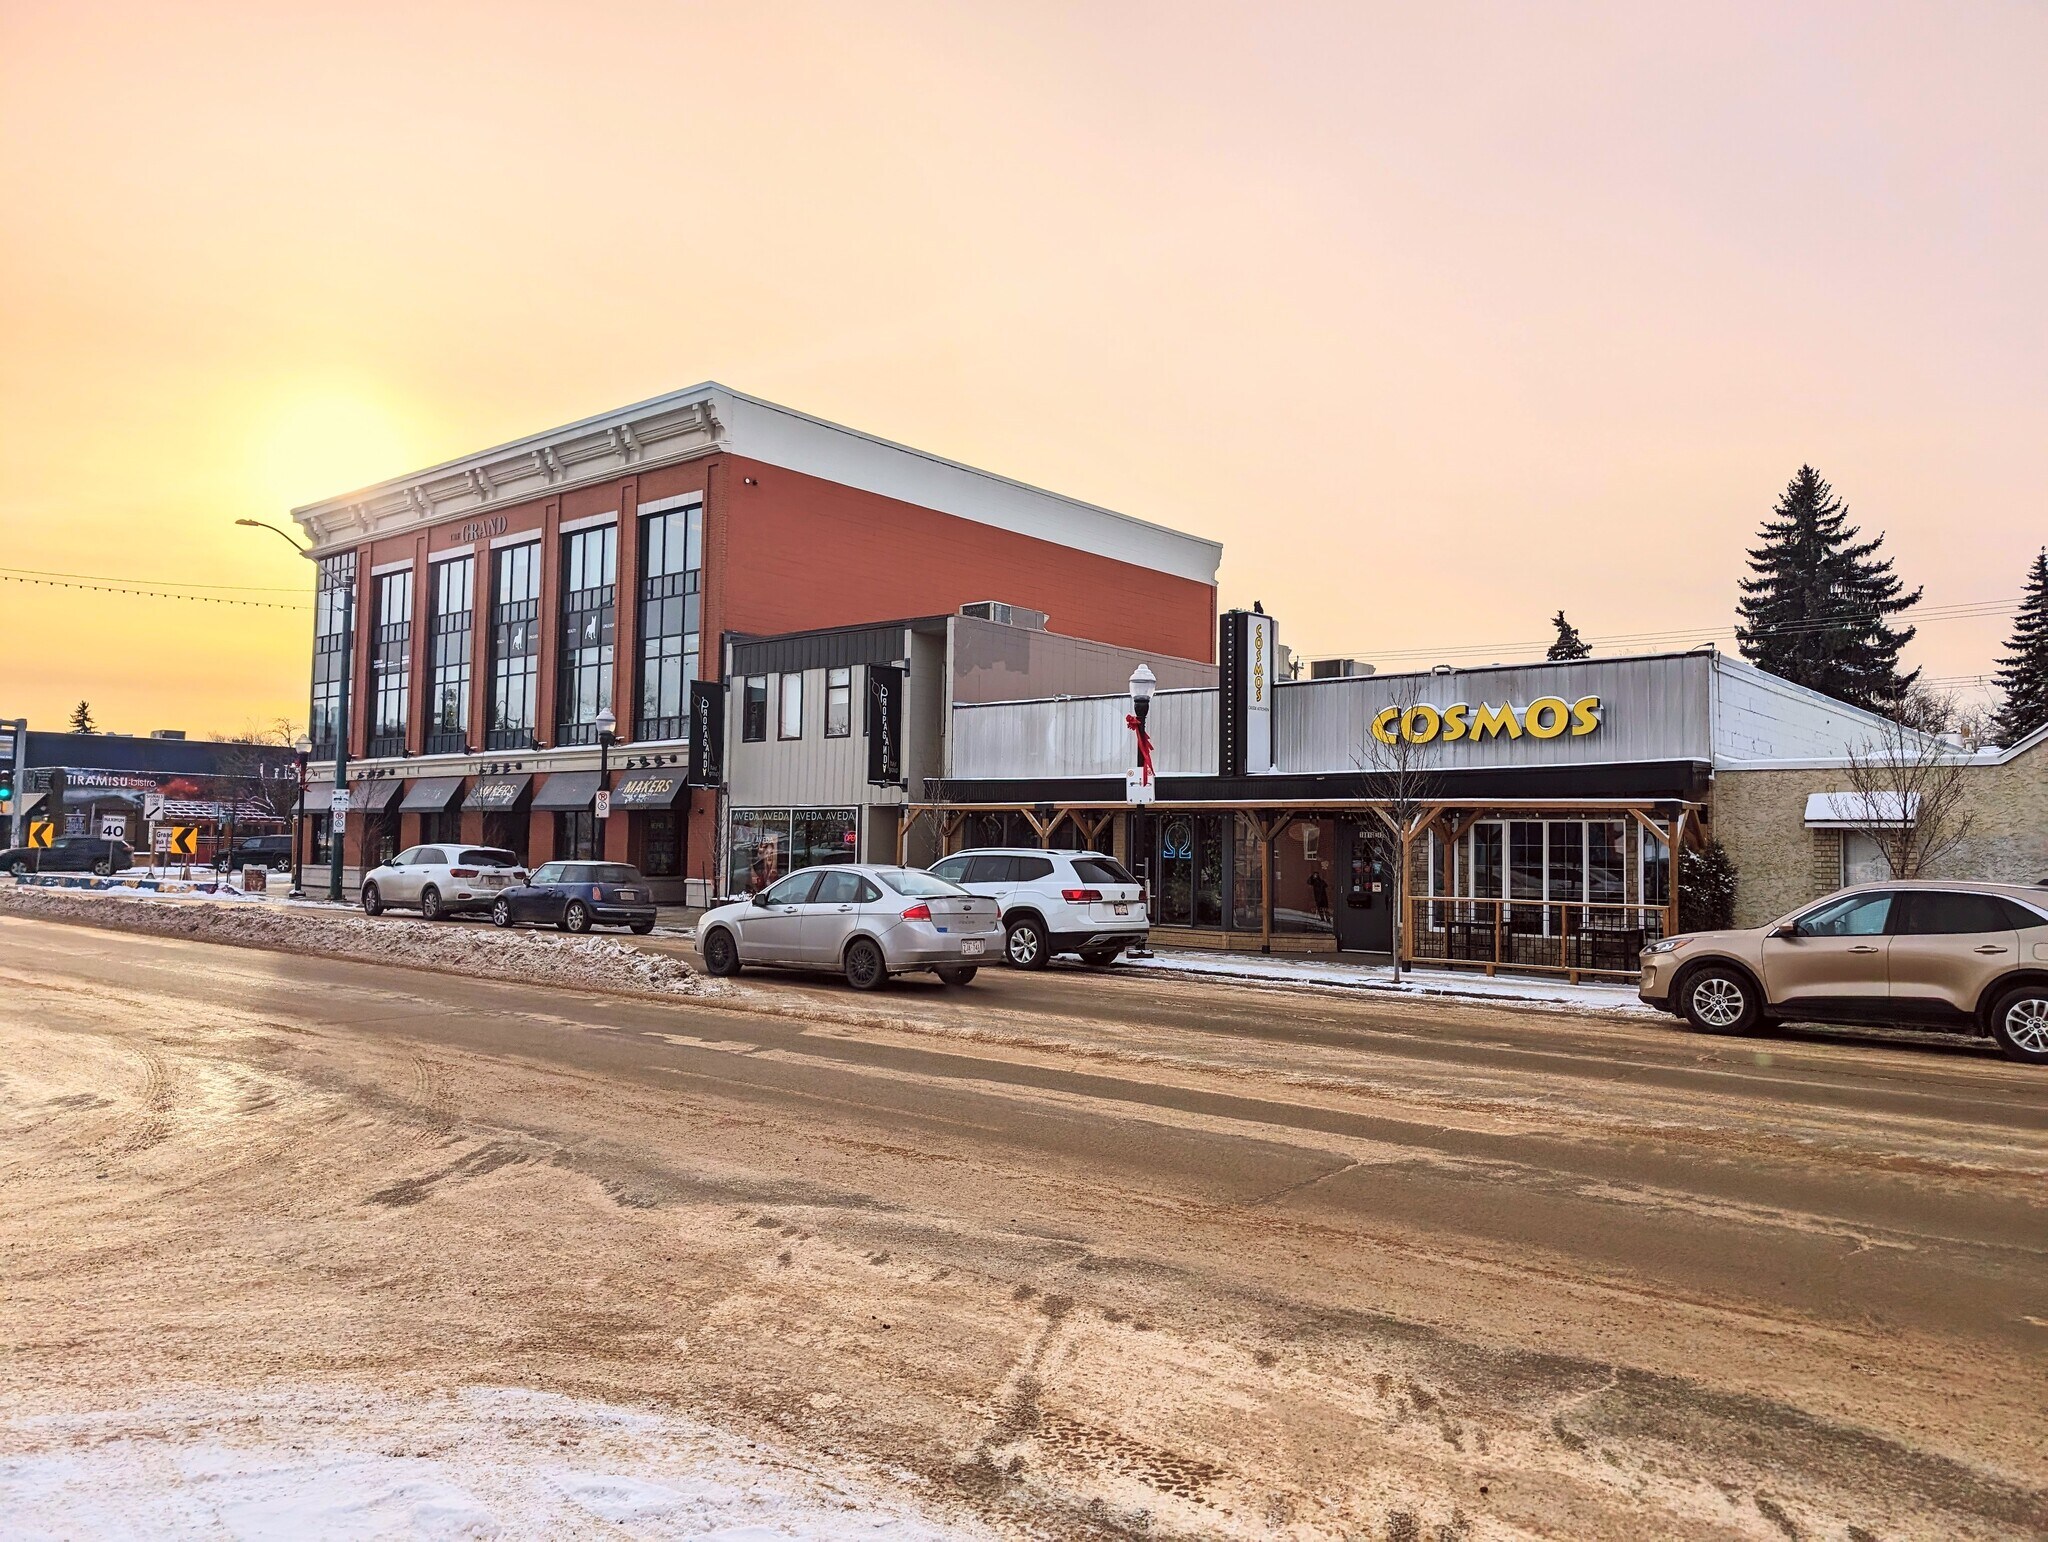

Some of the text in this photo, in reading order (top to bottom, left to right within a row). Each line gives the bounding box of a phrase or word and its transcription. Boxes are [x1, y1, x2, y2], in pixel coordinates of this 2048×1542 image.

[462, 516, 508, 542] GRAND
[1254, 623, 1264, 702] COSMOS
[1370, 696, 1601, 745] COSMOS
[66, 774, 128, 787] TIRAMISU
[623, 779, 673, 794] MAKERS
[102, 825, 124, 837] 40
